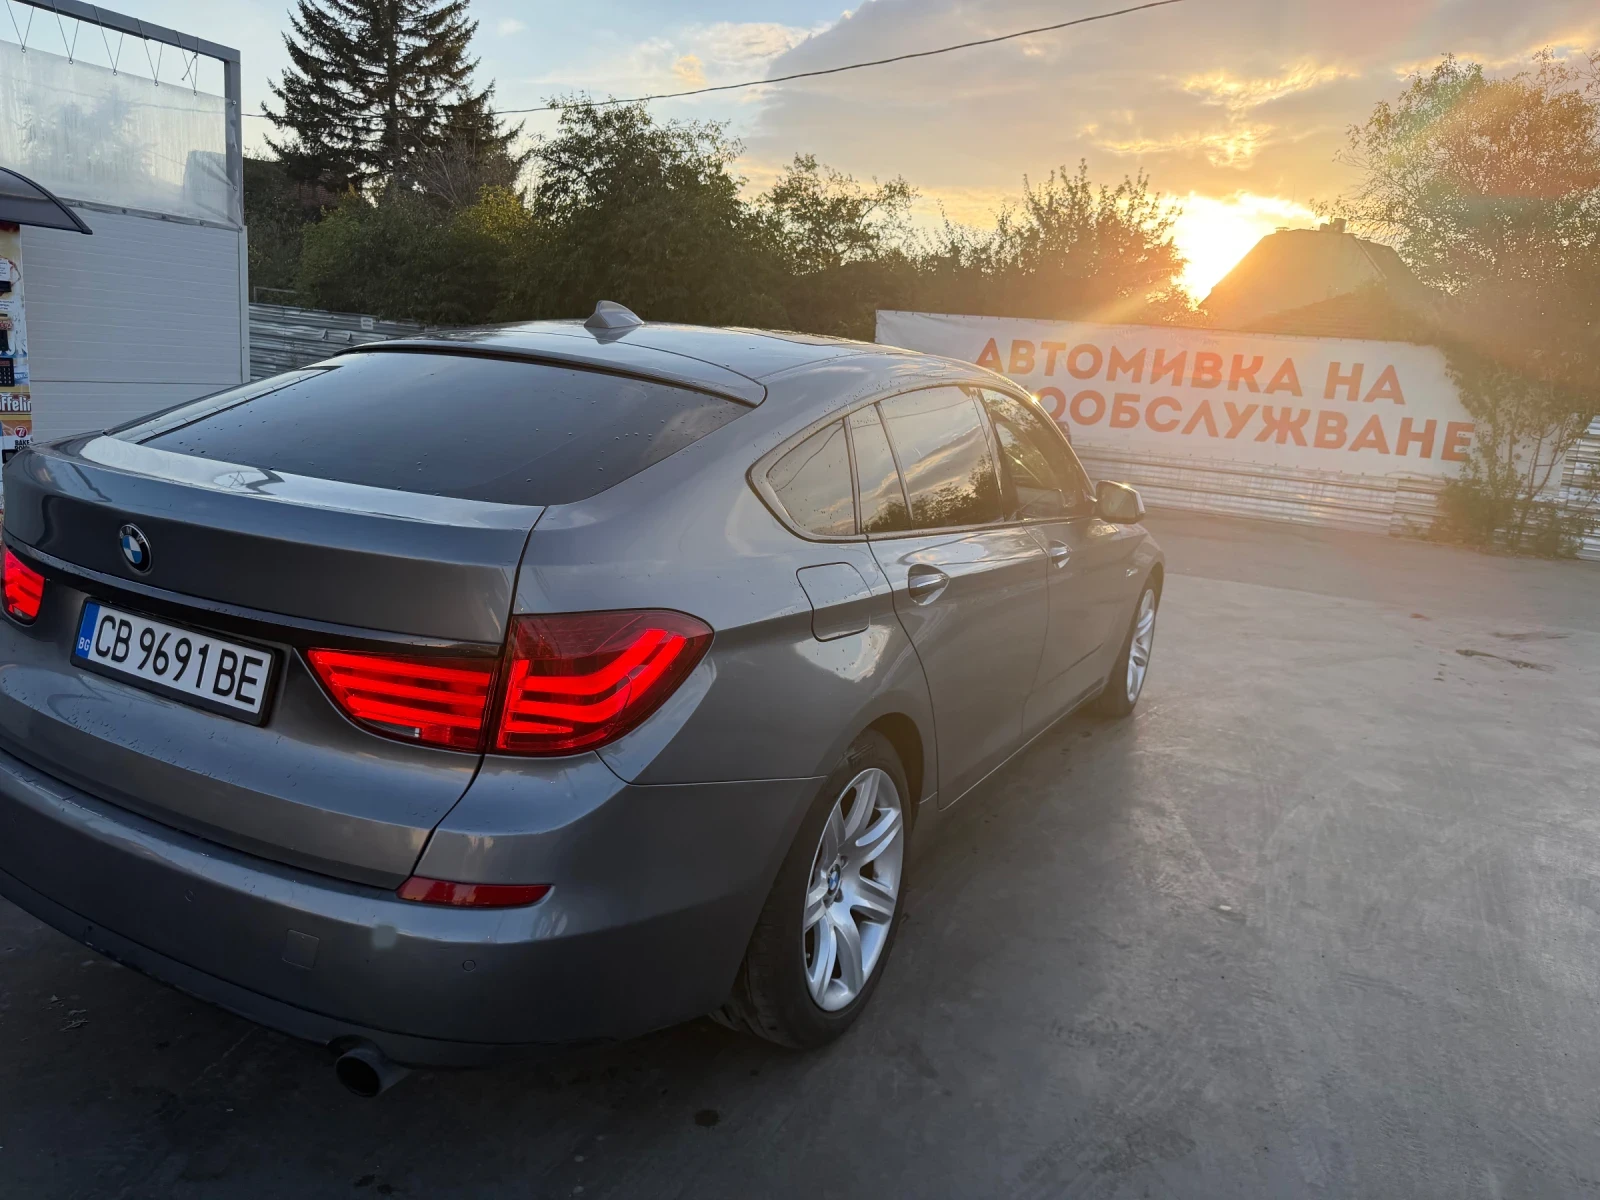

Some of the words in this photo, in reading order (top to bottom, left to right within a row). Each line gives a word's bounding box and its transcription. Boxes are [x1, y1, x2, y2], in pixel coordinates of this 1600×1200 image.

[976, 337, 1303, 397] АВТОМИВКА
[1323, 362, 1406, 405] НА
[1034, 386, 1475, 462] ООБСЛУЖВАНЕ
[78, 637, 91, 651] BG
[137, 627, 210, 689] 9691
